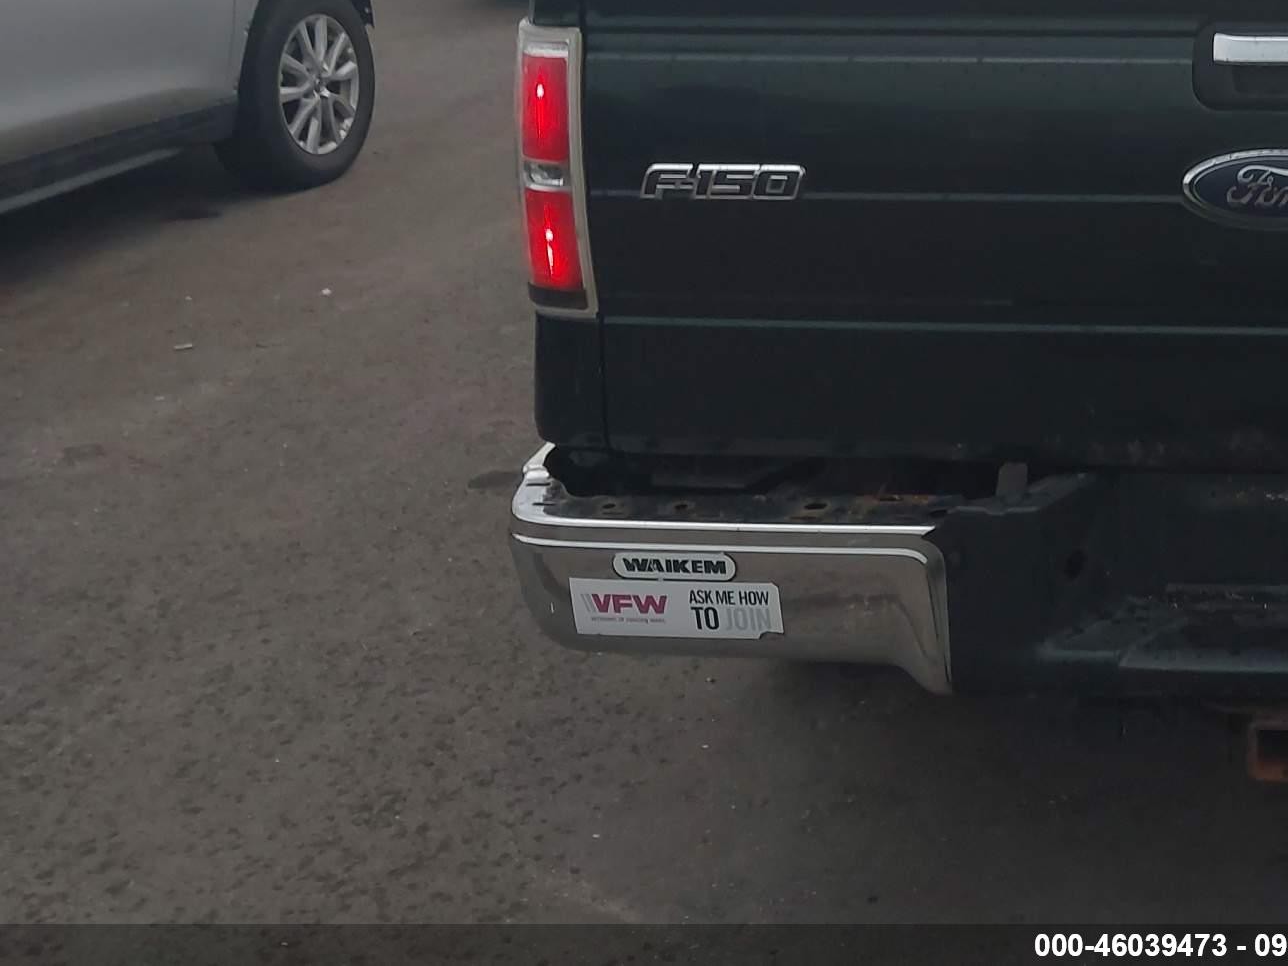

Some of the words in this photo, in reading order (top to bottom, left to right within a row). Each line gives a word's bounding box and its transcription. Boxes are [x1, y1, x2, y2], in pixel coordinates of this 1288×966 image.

[622, 557, 727, 575] WAIKEM
[591, 593, 668, 615] VFW
[689, 589, 714, 605] ASK
[715, 590, 736, 605] ME
[738, 590, 769, 606] HOW
[690, 606, 720, 631] TO
[725, 607, 773, 632] JOIN
